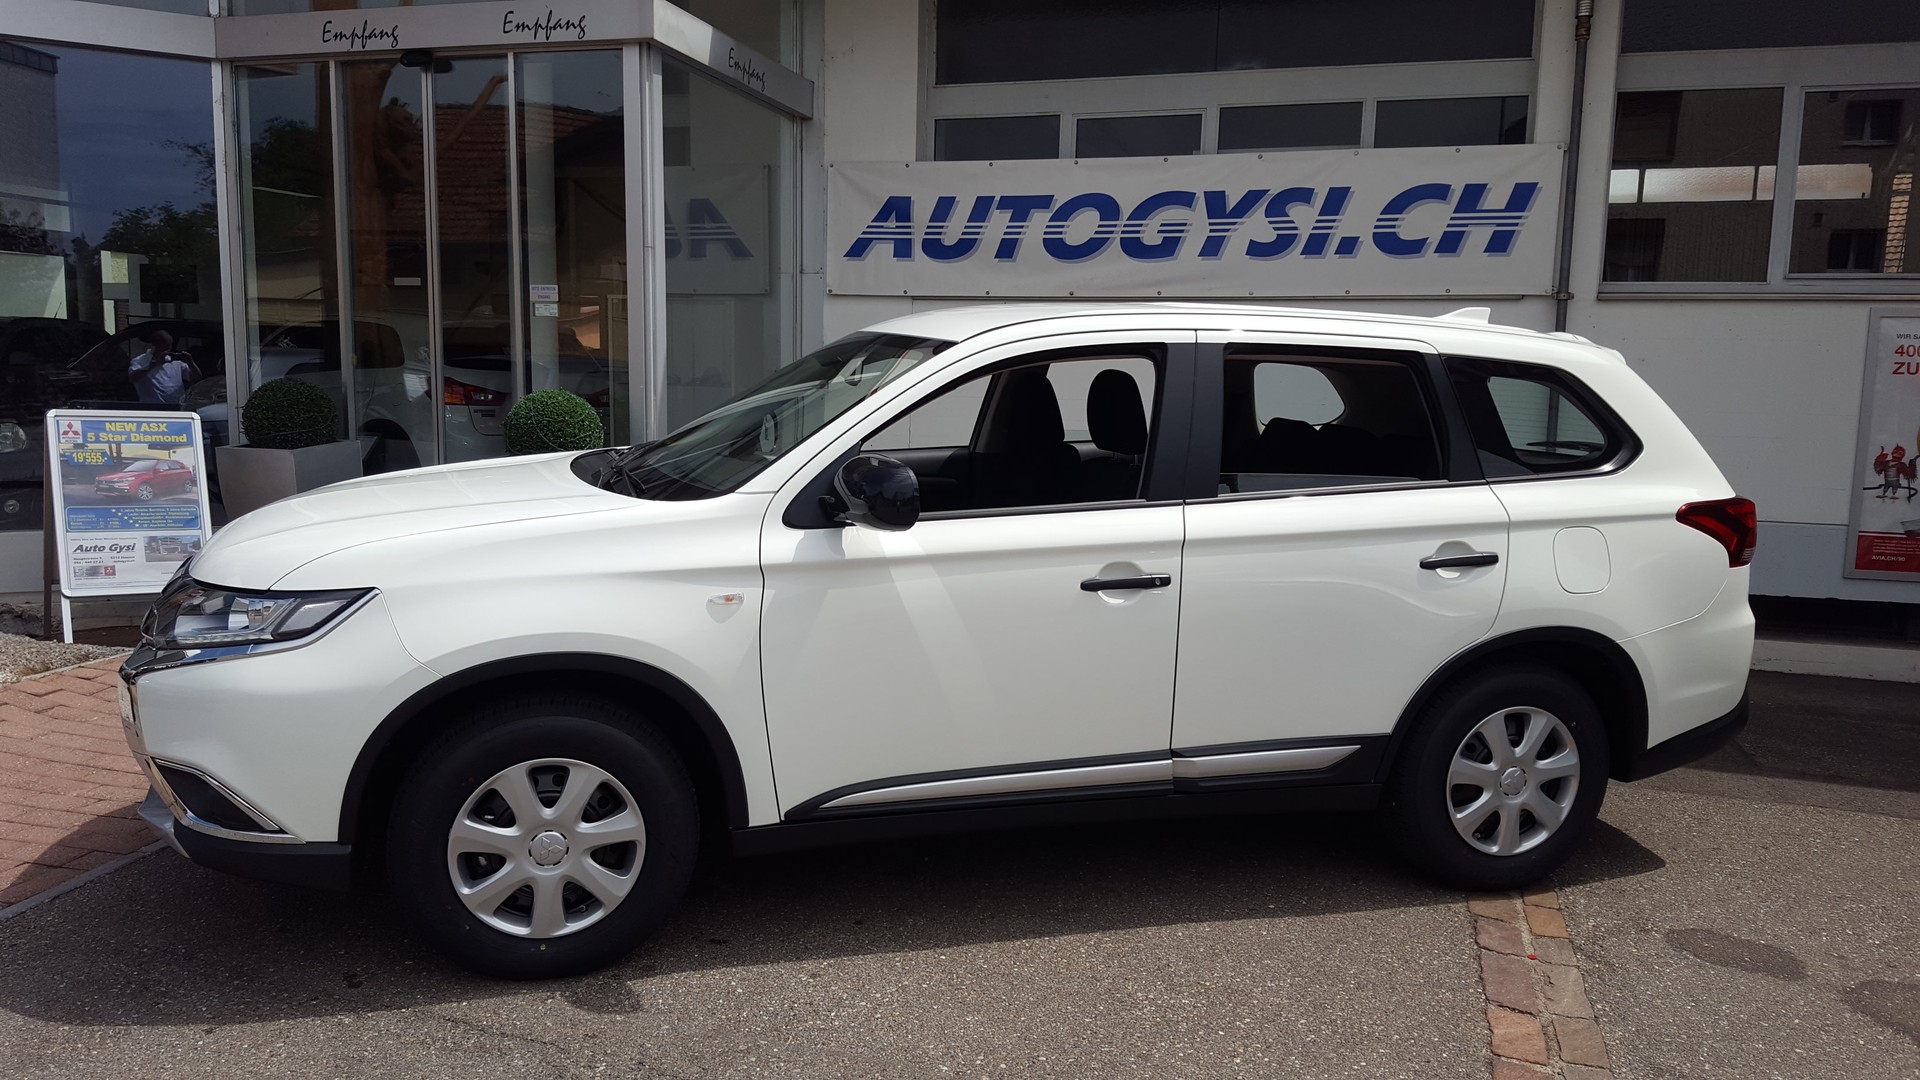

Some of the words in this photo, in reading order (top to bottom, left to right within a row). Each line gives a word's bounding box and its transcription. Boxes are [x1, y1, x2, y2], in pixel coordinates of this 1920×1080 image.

[321, 19, 399, 49] Empfang
[502, 10, 587, 41] Empfang
[728, 47, 766, 92] Empfang
[843, 182, 1543, 263] AUTOGYSI.CH
[87, 432, 95, 442] 5
[99, 432, 127, 442] Star
[130, 433, 187, 443] Diamond
[105, 422, 137, 432] NEW
[141, 422, 168, 432] ASX
[73, 544, 107, 553] Auto
[108, 542, 137, 554] Gysi
